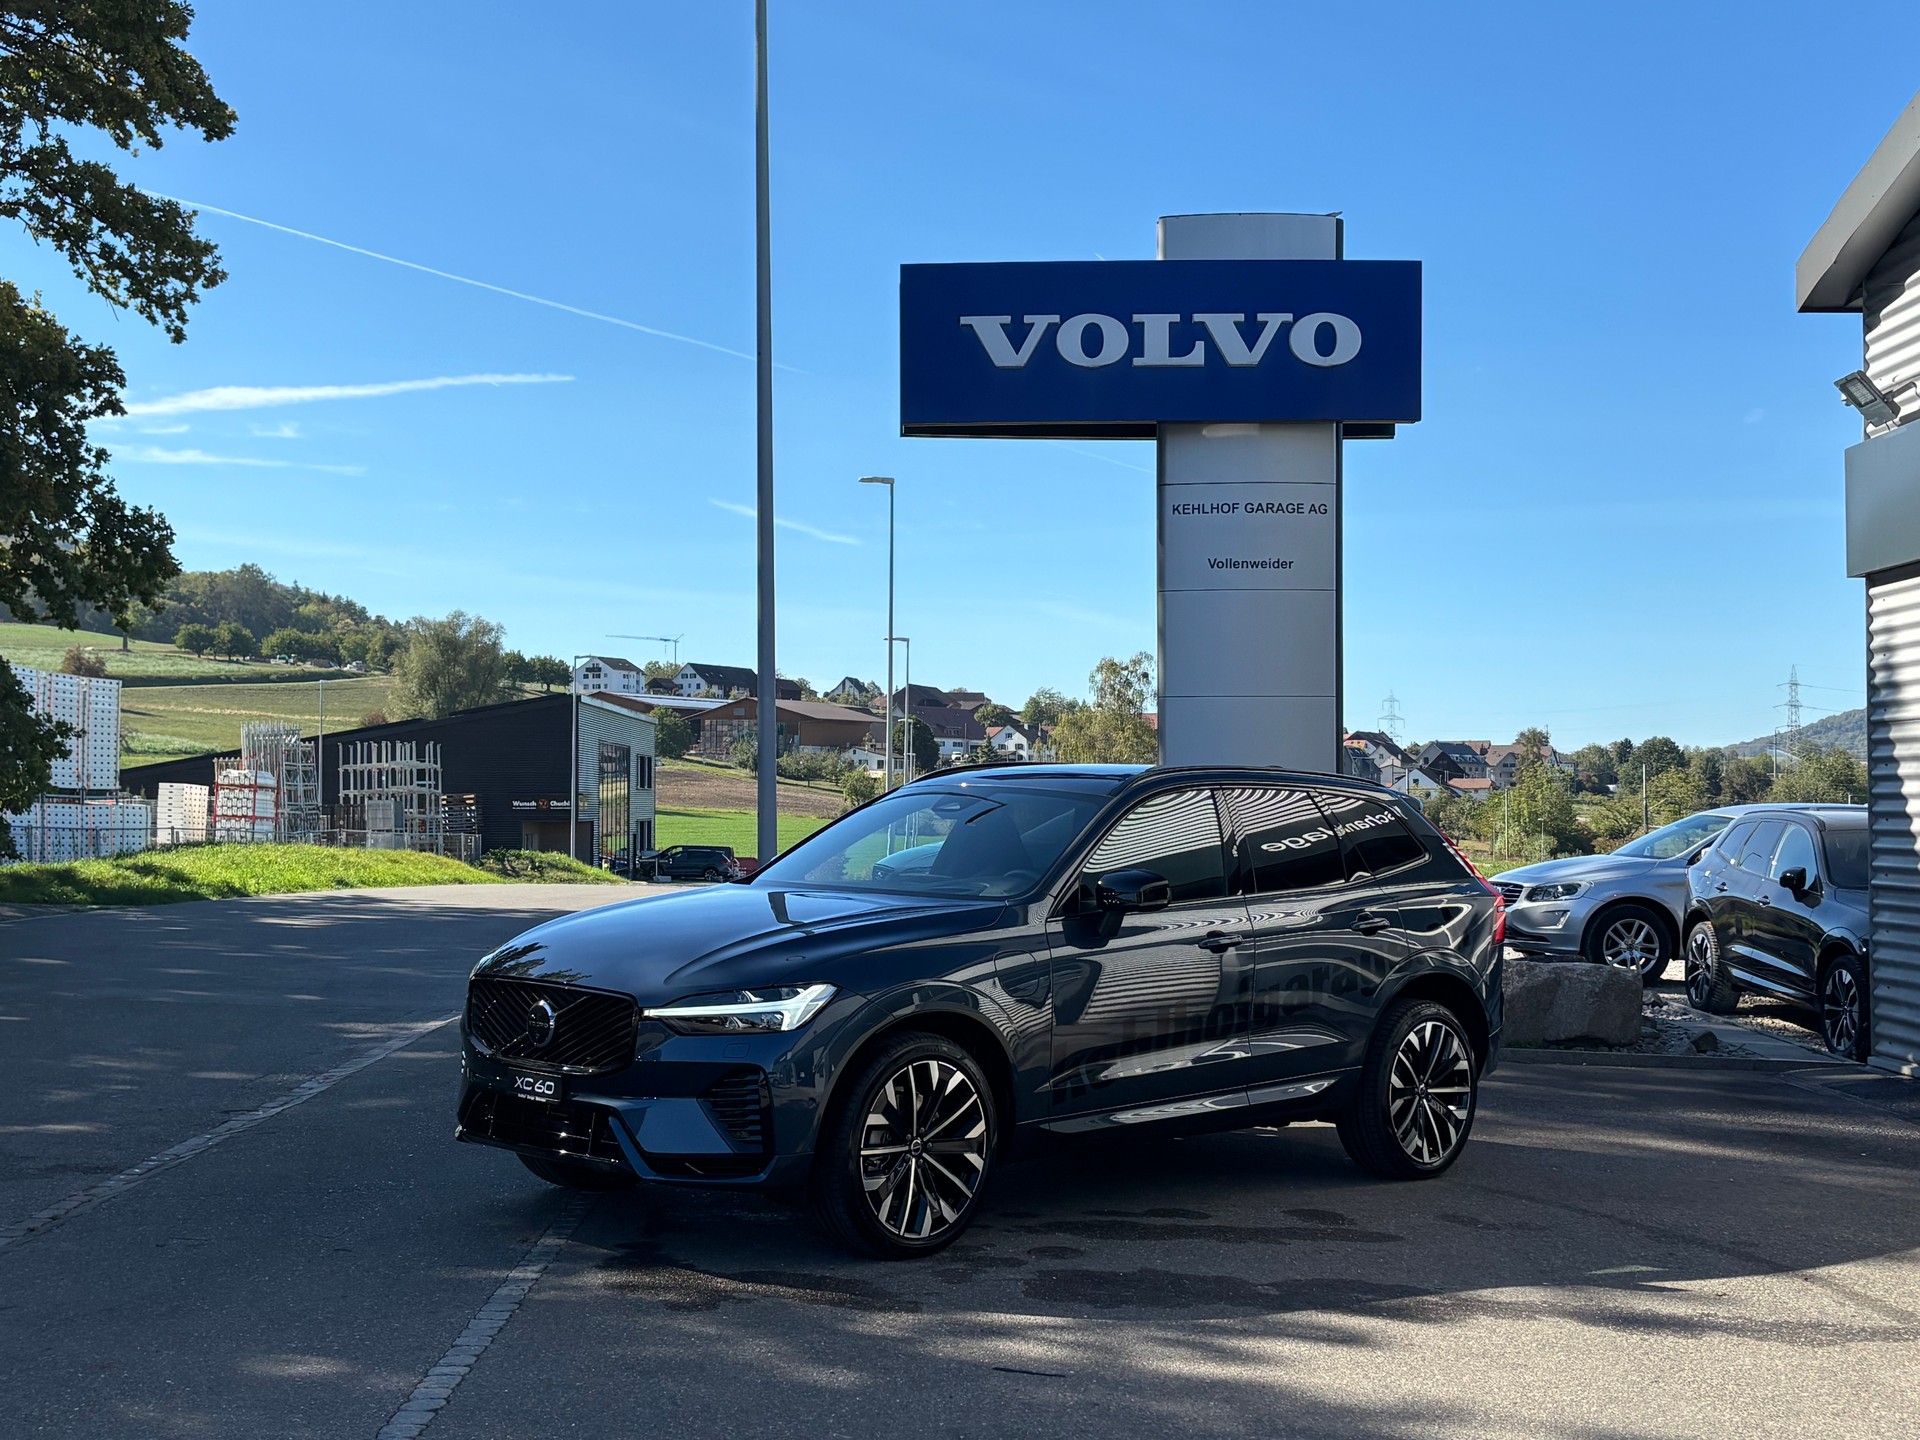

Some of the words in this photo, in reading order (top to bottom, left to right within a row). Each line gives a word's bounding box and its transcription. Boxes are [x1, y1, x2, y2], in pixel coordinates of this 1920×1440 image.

[959, 312, 1362, 368] VOLVO
[1172, 502, 1240, 515] KEHLHOF
[1244, 502, 1305, 514] GARAGE
[1308, 503, 1328, 515] AG
[1208, 557, 1294, 570] Vollenweider
[514, 1076, 555, 1095] XC60
